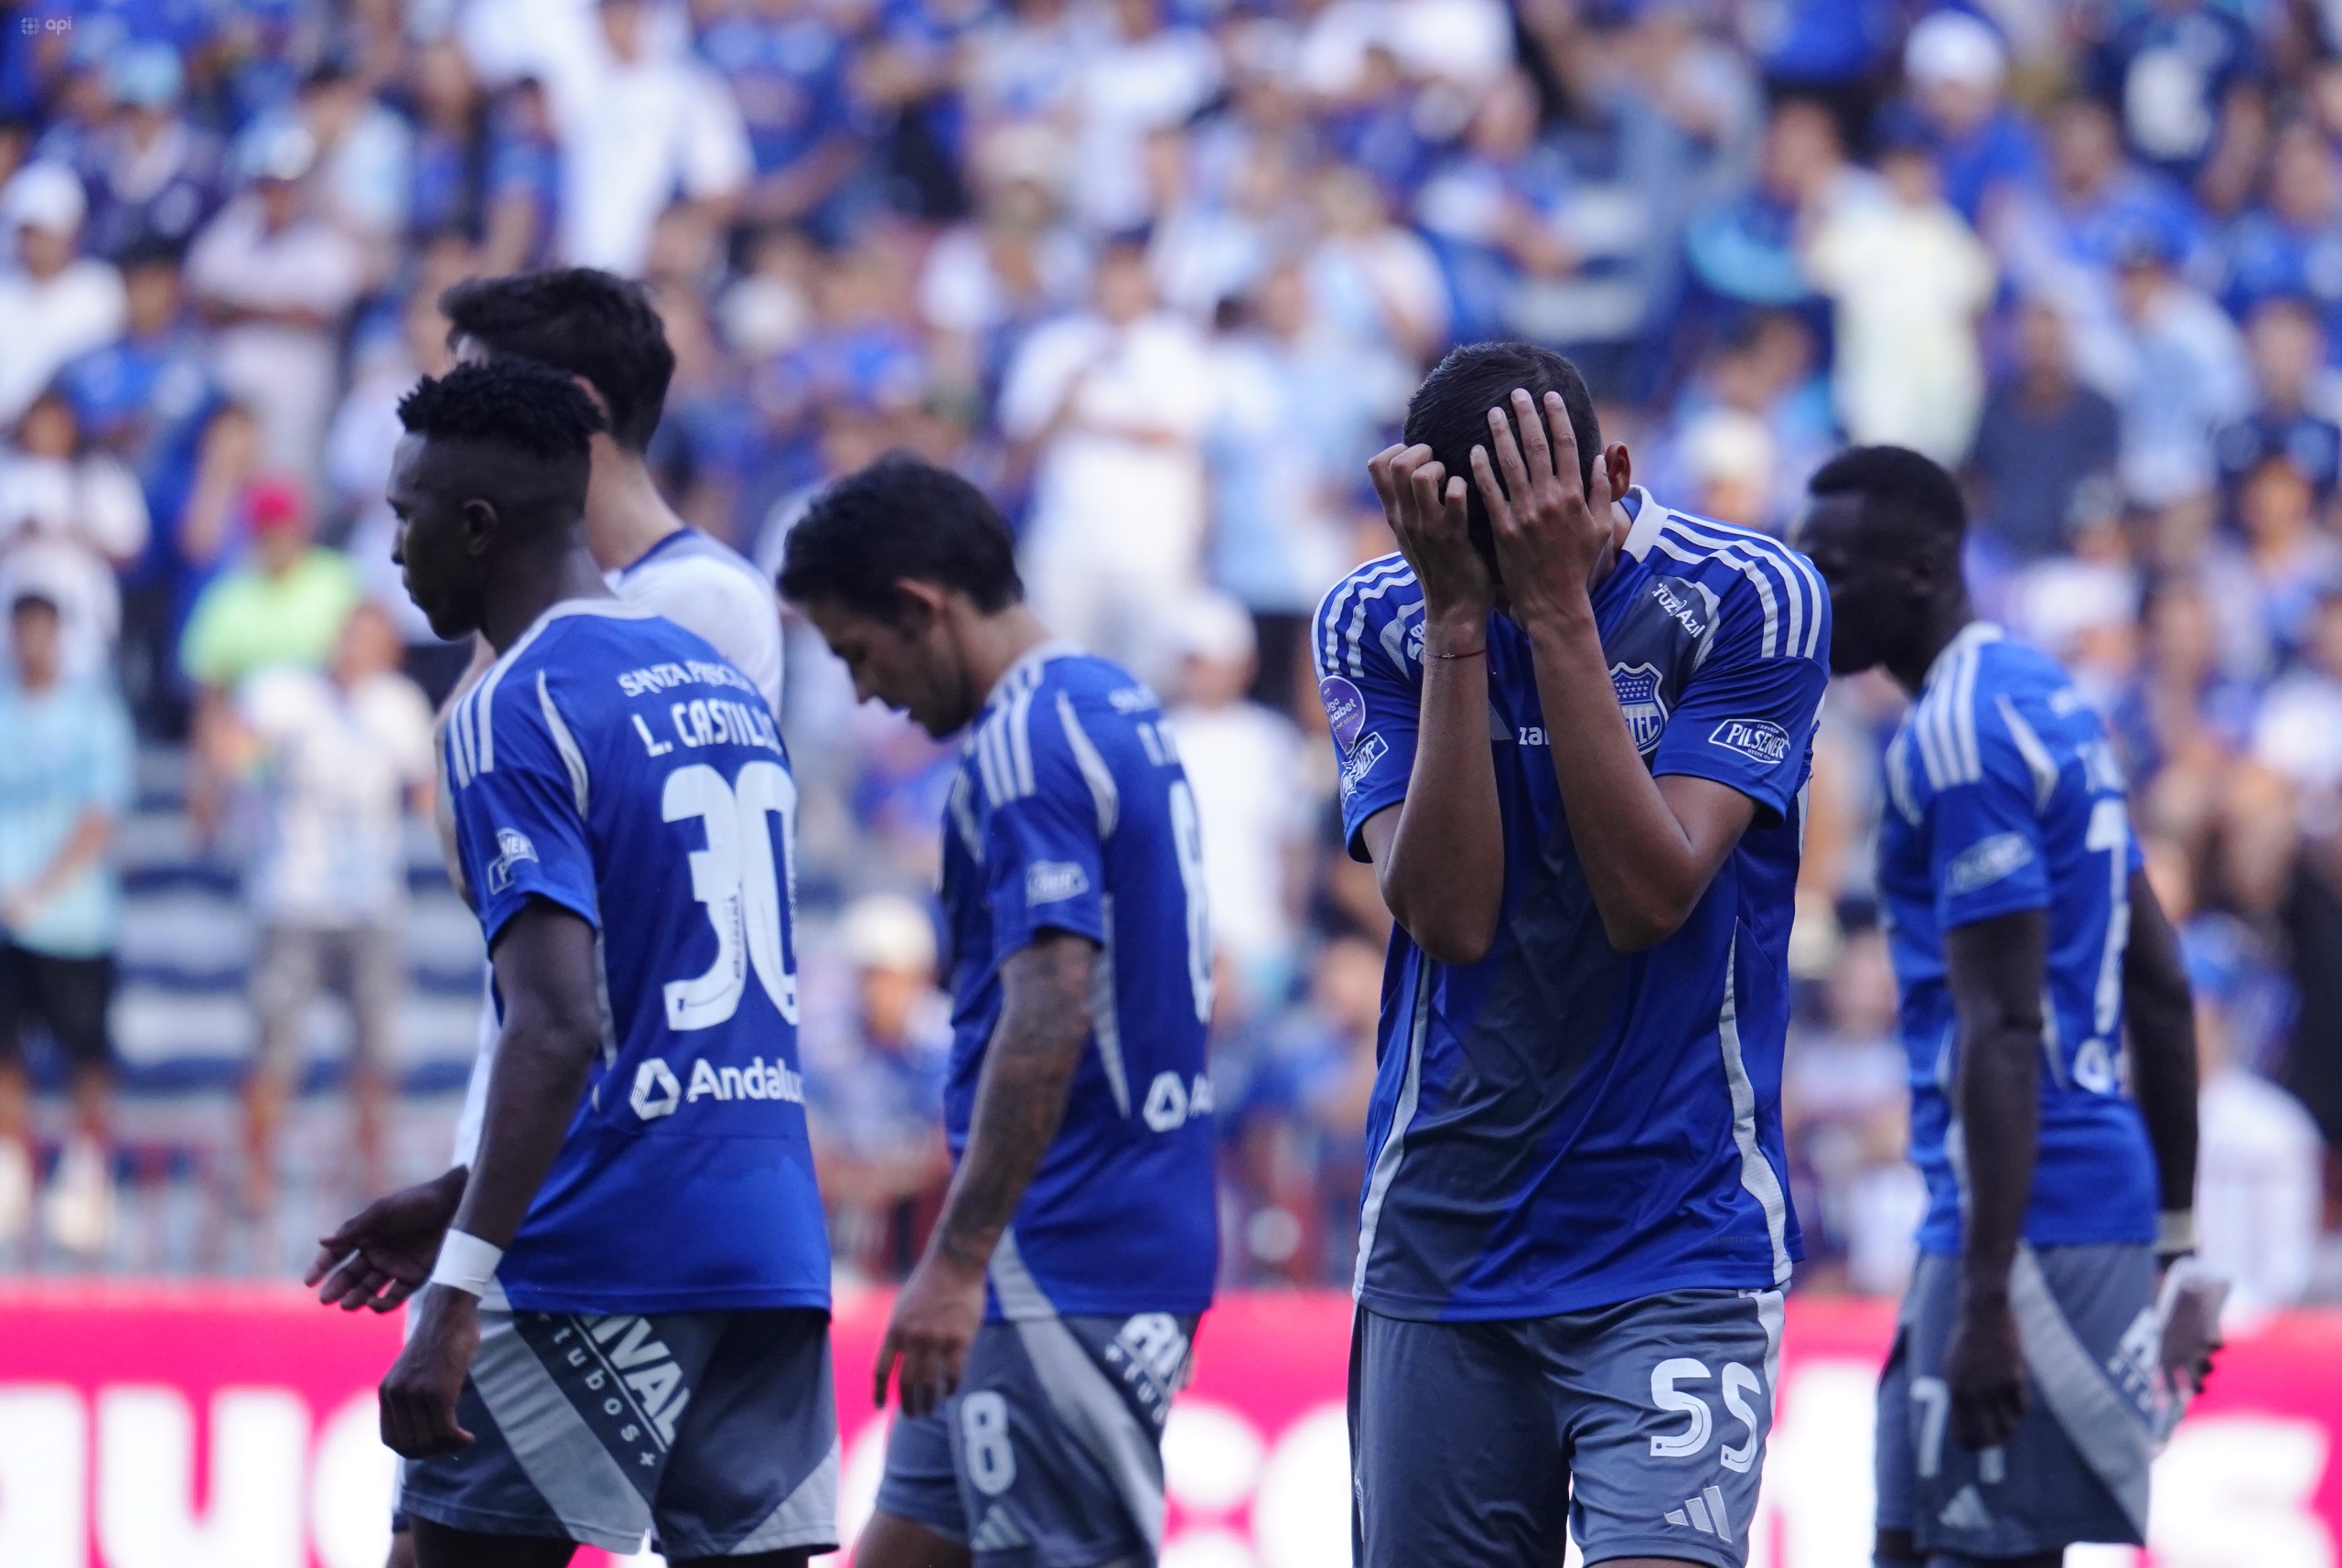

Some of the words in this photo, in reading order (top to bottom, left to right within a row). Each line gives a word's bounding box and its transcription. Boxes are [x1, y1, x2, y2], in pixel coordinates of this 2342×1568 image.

[618, 661, 693, 697] SANTA
[631, 714, 673, 757] L.
[1725, 724, 1784, 759] PILSENER
[662, 760, 799, 1031] 30
[962, 1390, 1017, 1496] 8
